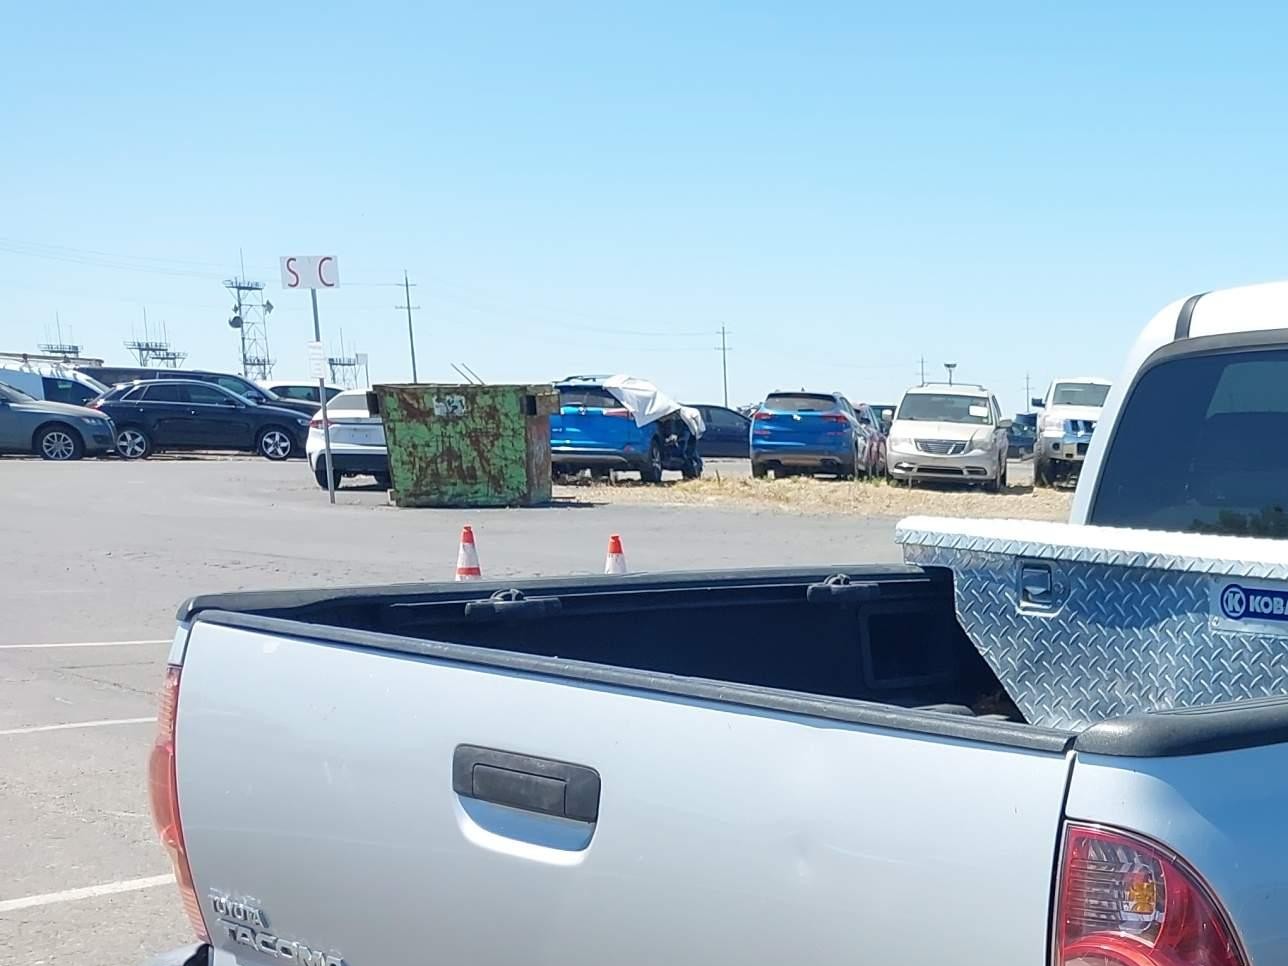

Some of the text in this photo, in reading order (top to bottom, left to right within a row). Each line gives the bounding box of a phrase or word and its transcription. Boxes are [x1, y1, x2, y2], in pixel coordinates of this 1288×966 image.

[285, 256, 335, 288] S C
[207, 893, 270, 929] TOYOTA
